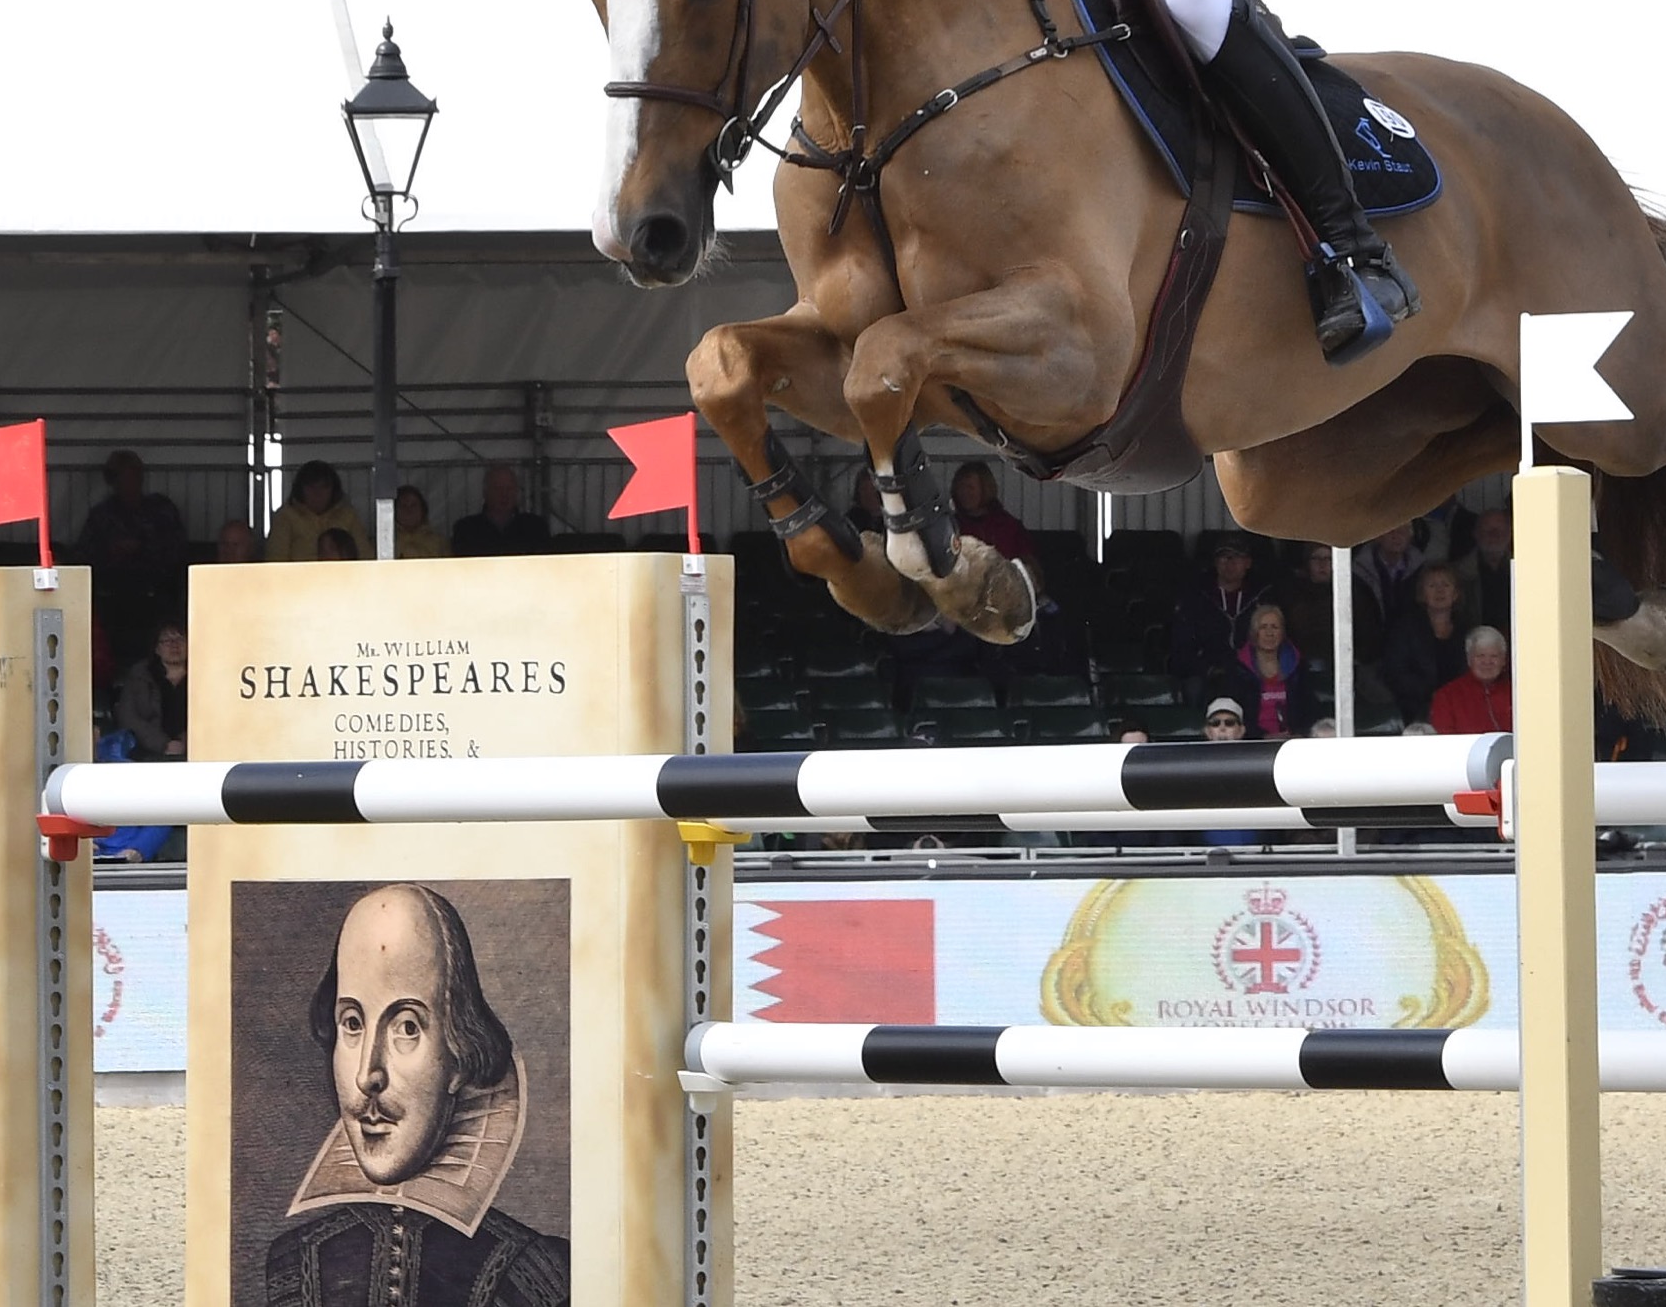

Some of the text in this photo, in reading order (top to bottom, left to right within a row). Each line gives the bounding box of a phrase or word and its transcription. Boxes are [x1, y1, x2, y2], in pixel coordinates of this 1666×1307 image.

[1347, 159, 1381, 171] Kevin
[384, 640, 470, 657] WILLIAM
[239, 661, 567, 700] SHAKESPEARES
[334, 712, 450, 735] COMEDIES,
[467, 739, 480, 759] &
[1158, 998, 1376, 1019] ROYAL WINDSOR
